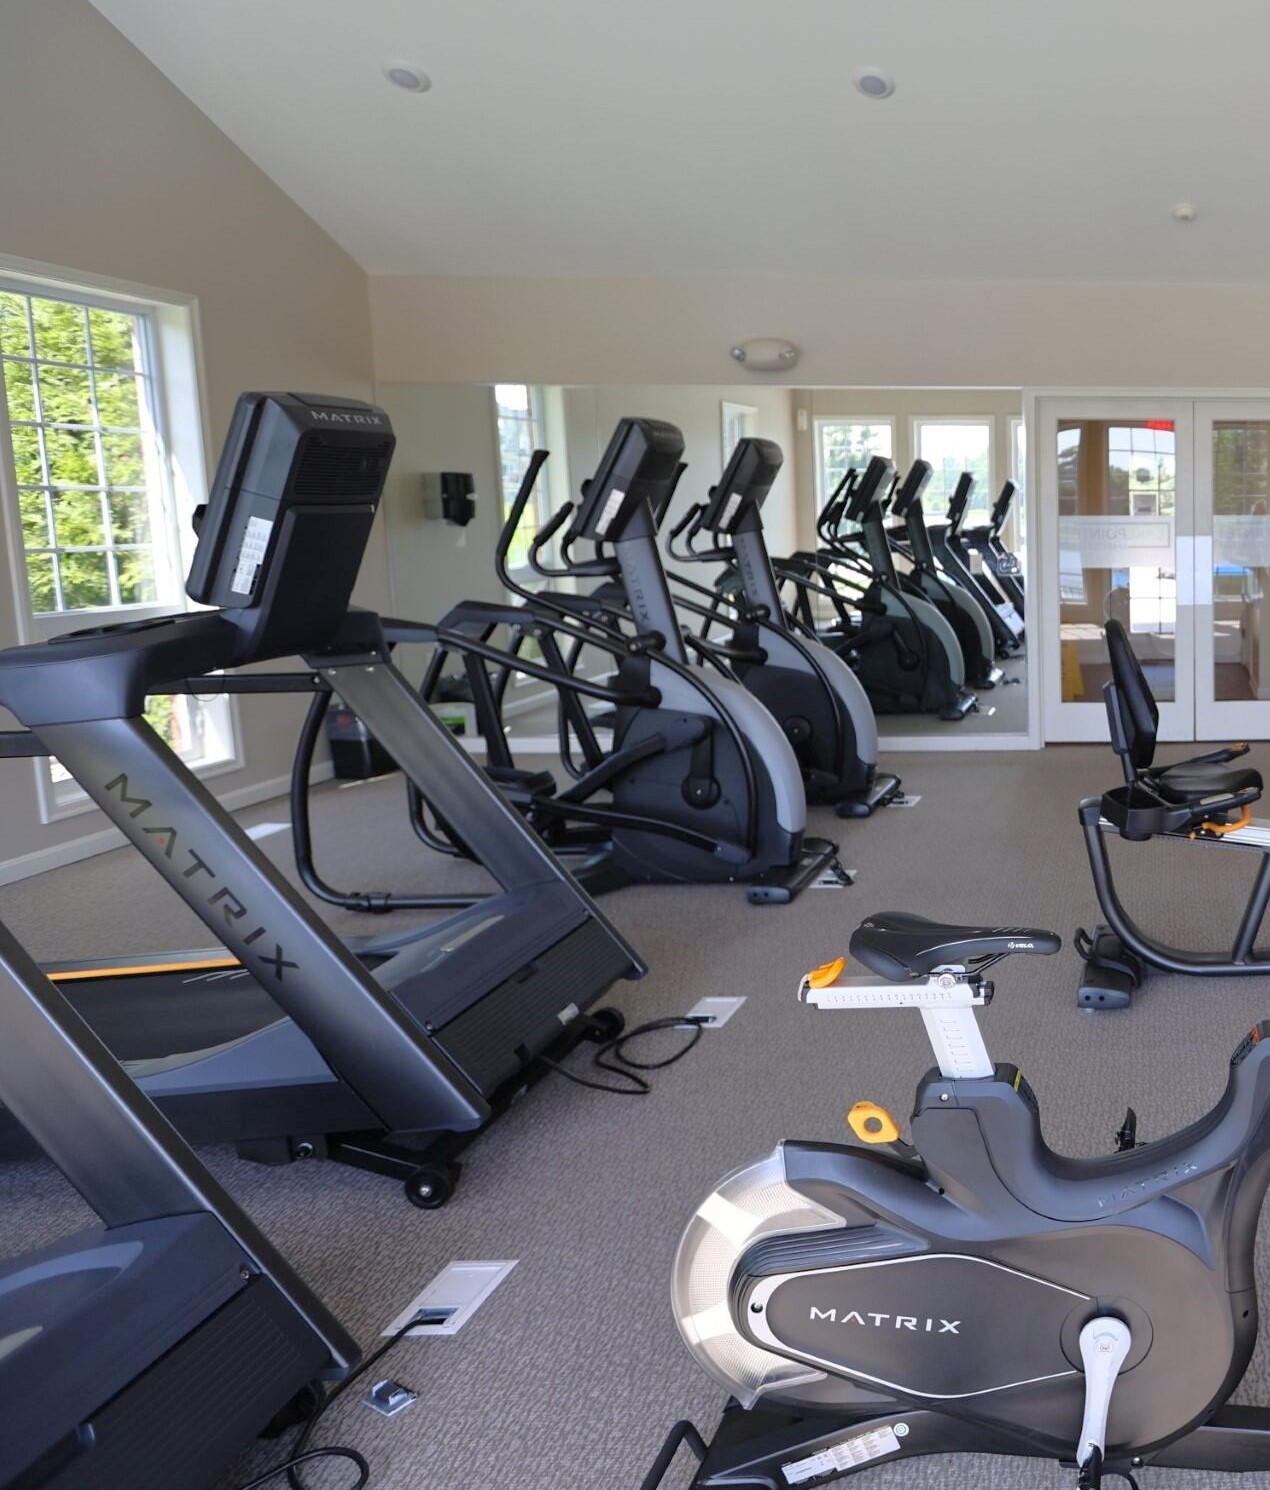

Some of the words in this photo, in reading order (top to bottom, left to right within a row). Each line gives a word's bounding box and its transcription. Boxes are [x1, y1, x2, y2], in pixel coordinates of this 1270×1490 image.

[311, 410, 382, 425] MATRIX
[104, 772, 300, 983] MATRIX
[810, 1306, 961, 1334] MATRIX
